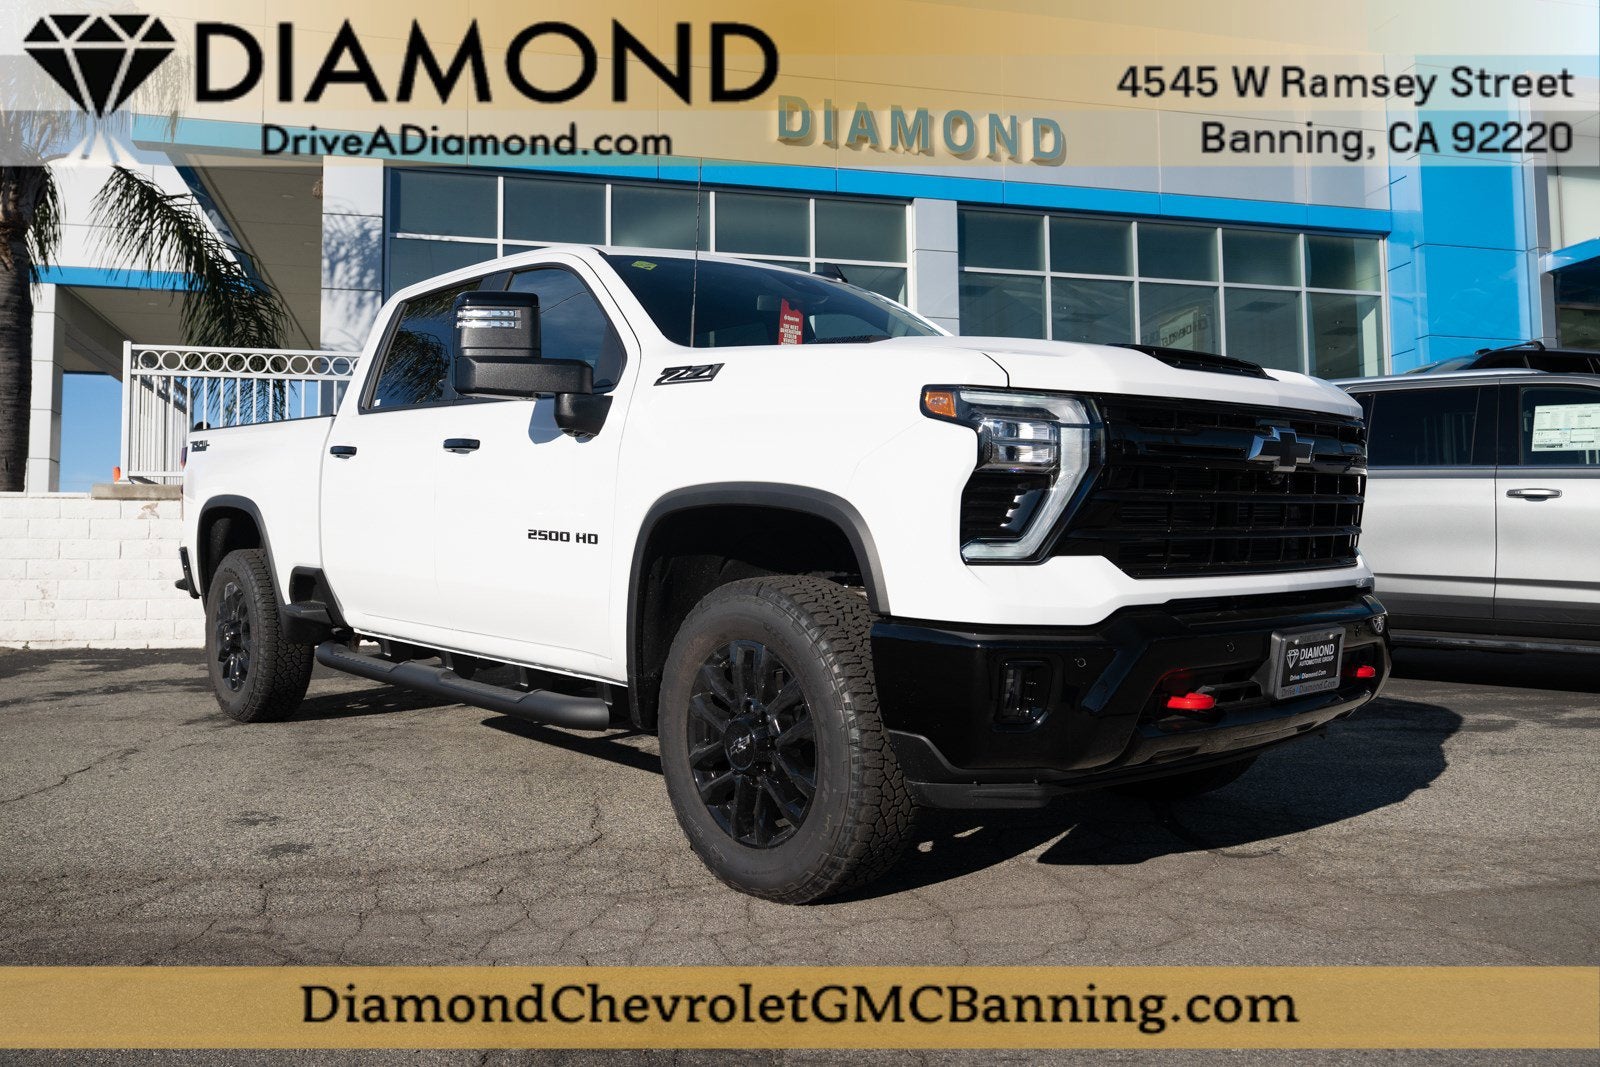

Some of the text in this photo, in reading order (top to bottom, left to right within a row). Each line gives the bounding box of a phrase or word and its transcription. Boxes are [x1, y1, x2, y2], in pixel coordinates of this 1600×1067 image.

[777, 95, 1066, 162] DIAMOND
[527, 529, 599, 545] 2500 HD
[1300, 643, 1335, 661] DIAMOND
